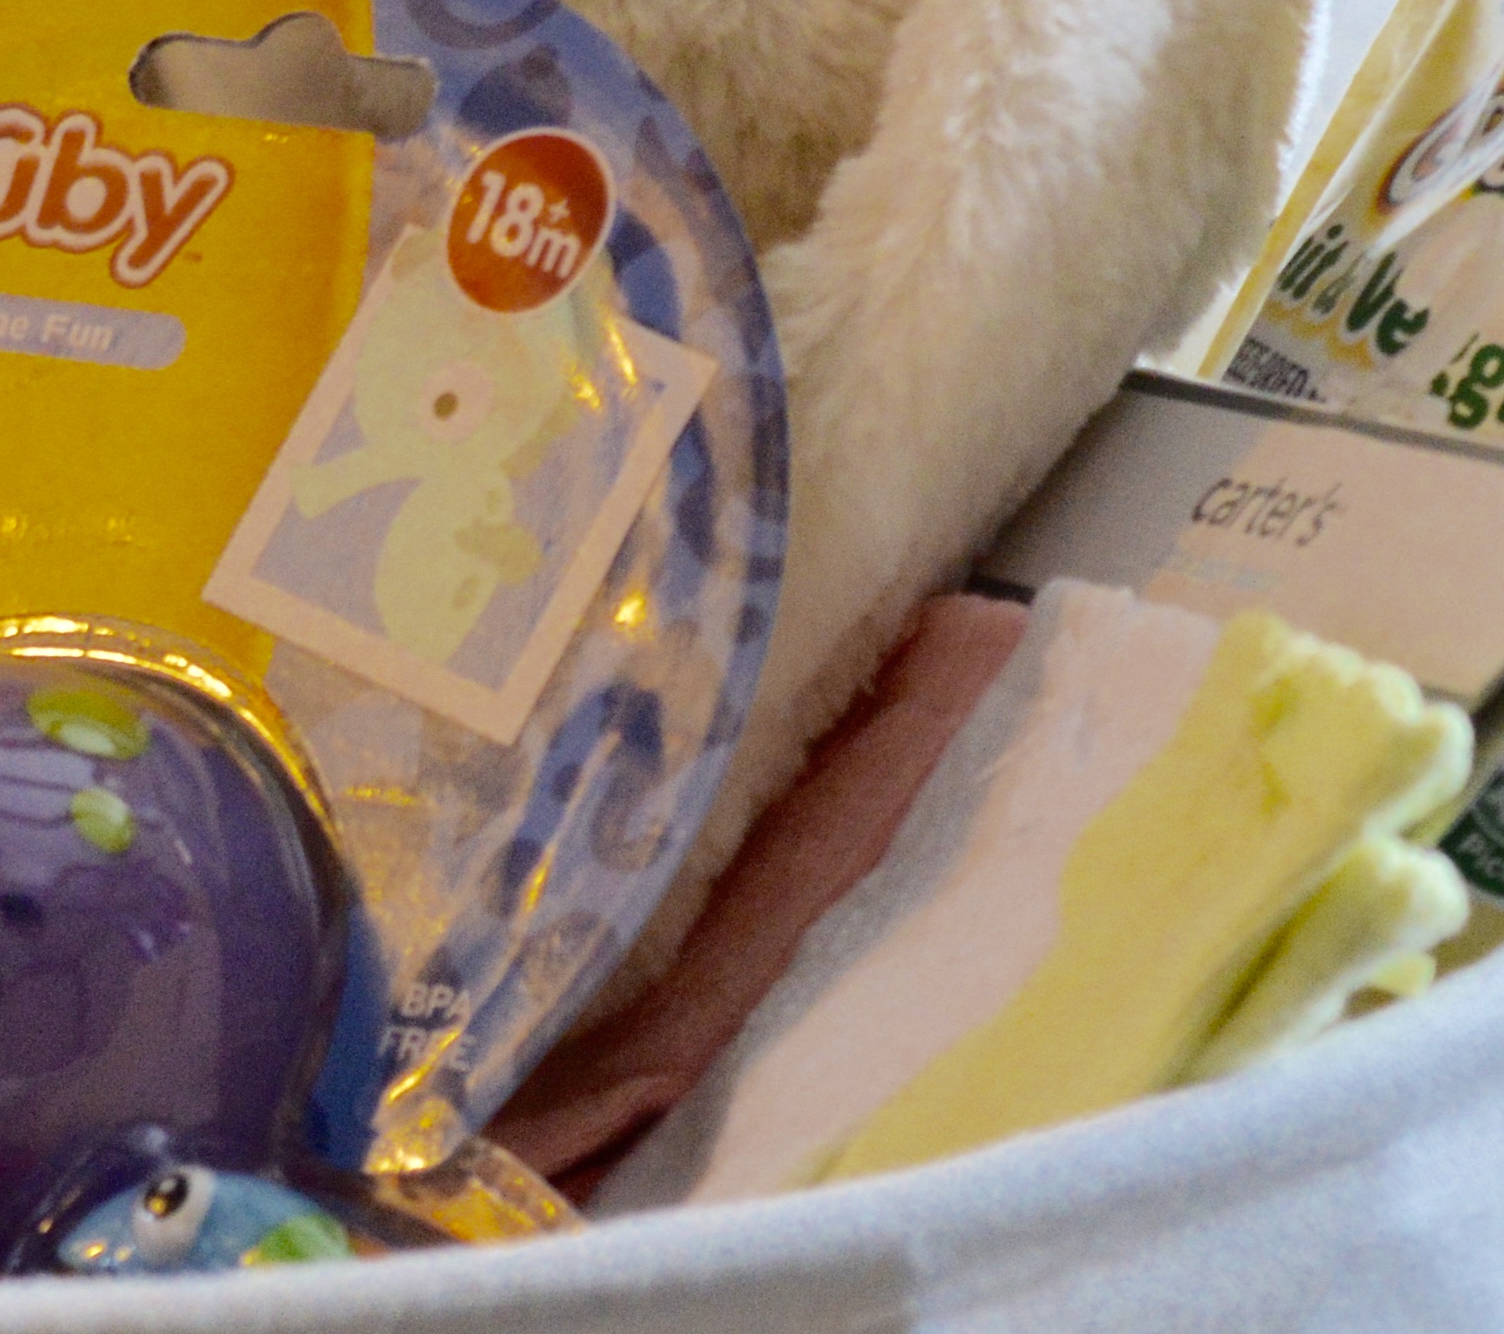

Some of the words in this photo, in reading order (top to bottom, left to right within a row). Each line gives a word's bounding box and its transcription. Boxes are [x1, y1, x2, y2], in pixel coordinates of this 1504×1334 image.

[40, 313, 114, 353] Fun
[1192, 477, 1345, 547] carter's
[399, 981, 473, 1023] BPA
